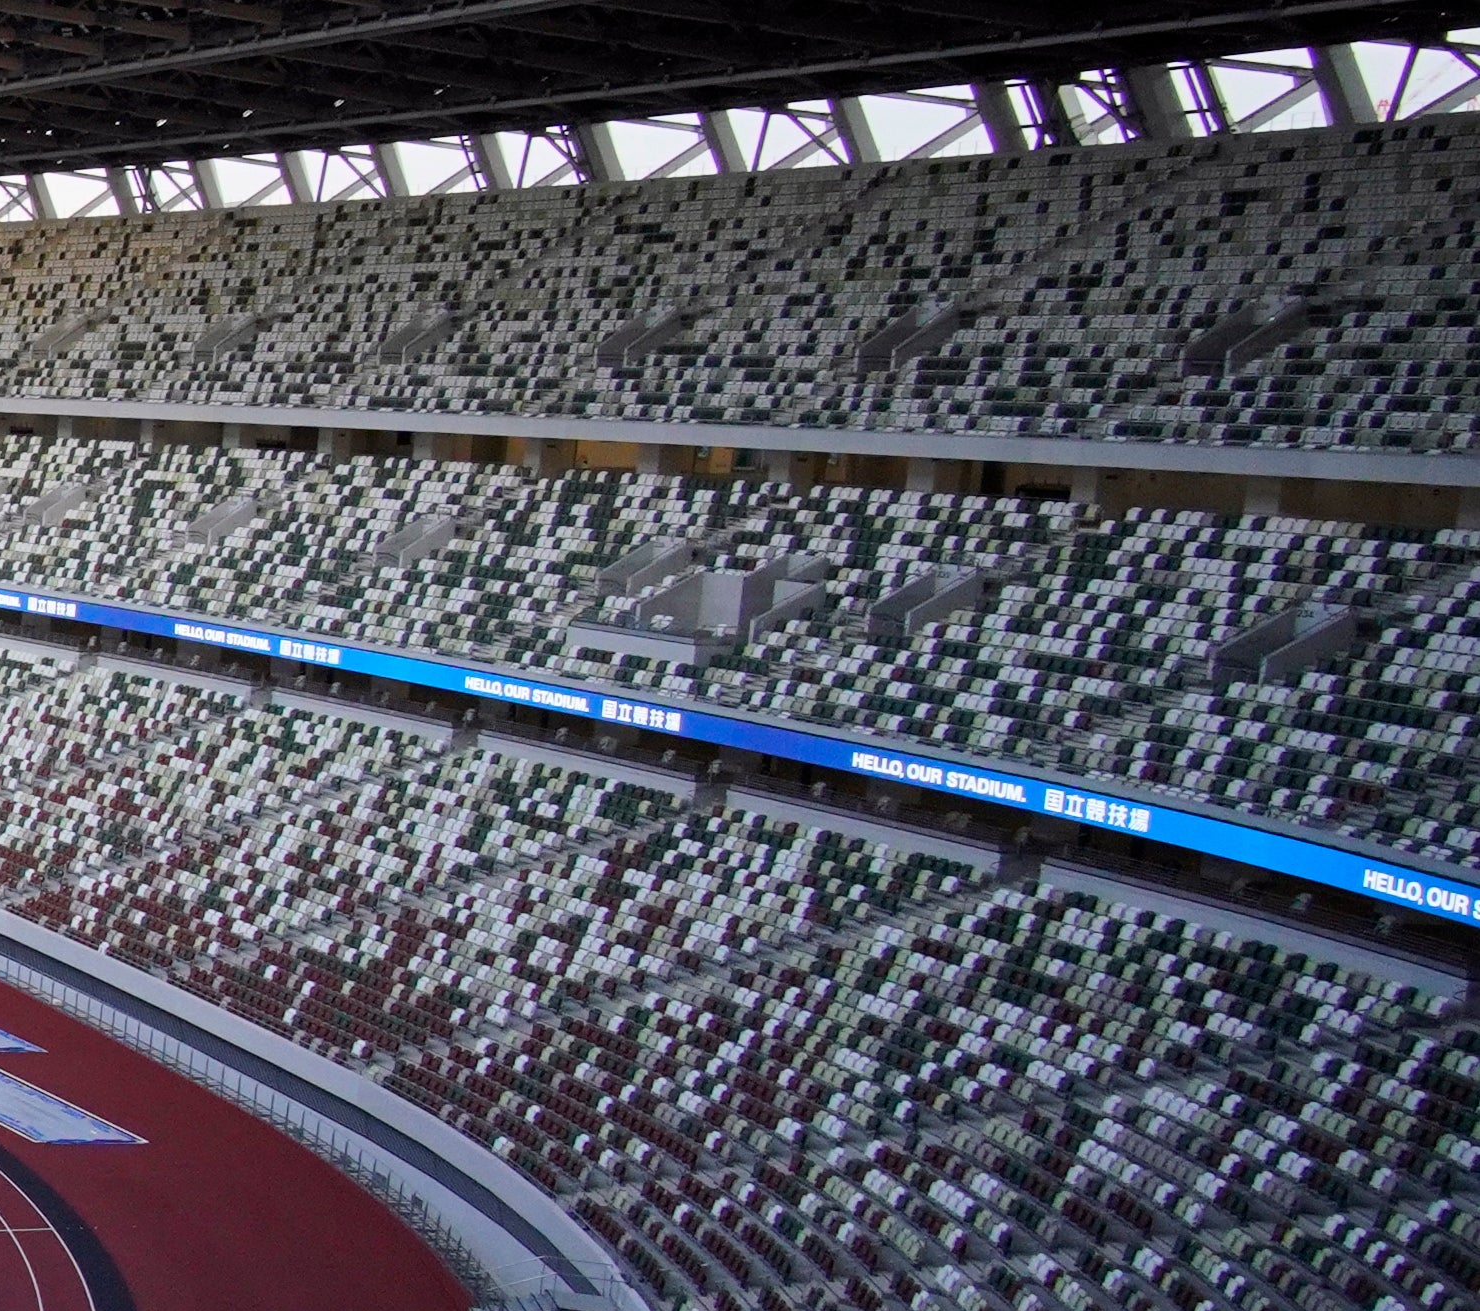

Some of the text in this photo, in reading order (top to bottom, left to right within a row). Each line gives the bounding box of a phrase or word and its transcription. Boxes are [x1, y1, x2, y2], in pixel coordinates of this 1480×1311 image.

[466, 677, 589, 712] HELLO, OUR STADIUM.
[853, 753, 1026, 802] HELLO, OUR STADIUM.
[1045, 789, 1149, 831] 国立競技場
[1364, 870, 1423, 904] HELLO,
[1427, 888, 1469, 914] OUR
